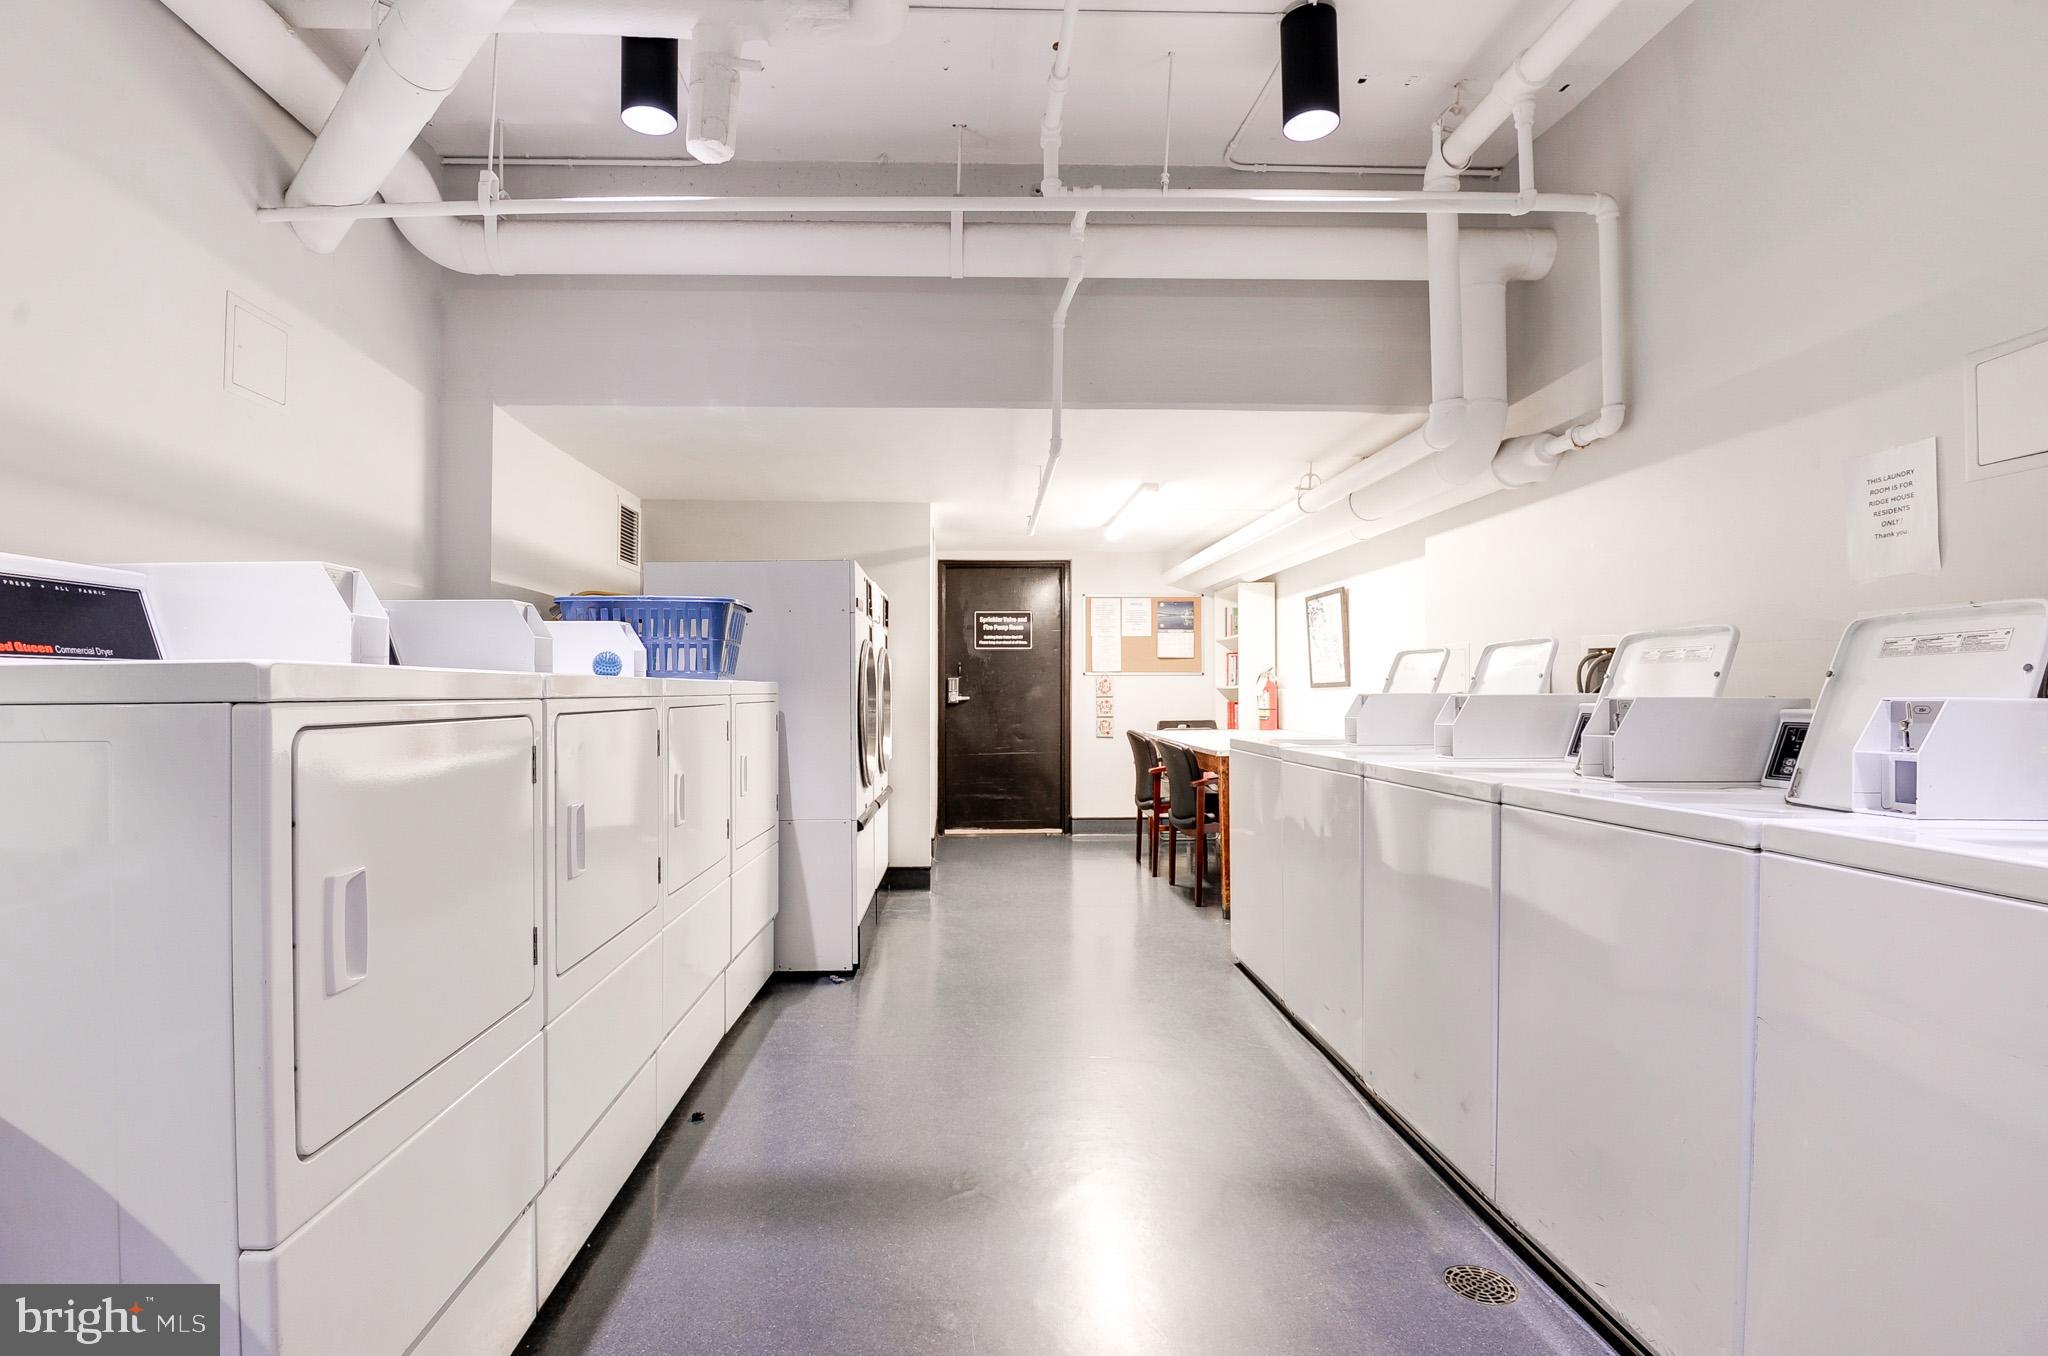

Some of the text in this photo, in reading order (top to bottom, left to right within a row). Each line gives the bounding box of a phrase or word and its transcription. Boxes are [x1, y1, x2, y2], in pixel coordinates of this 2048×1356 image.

[1867, 469, 1915, 485] THIS LAUNDRY
[1870, 486, 1890, 496] ROOM
[1899, 481, 1913, 489] FOR
[1868, 492, 1916, 508] RIDGE HOUSE
[1873, 505, 1911, 517] RESIDENTS
[1875, 531, 1895, 540] Thank
[3, 580, 31, 588] PRESS
[78, 588, 106, 596] FABRIC
[0, 641, 114, 657] ed Queen Commercial Dryer
